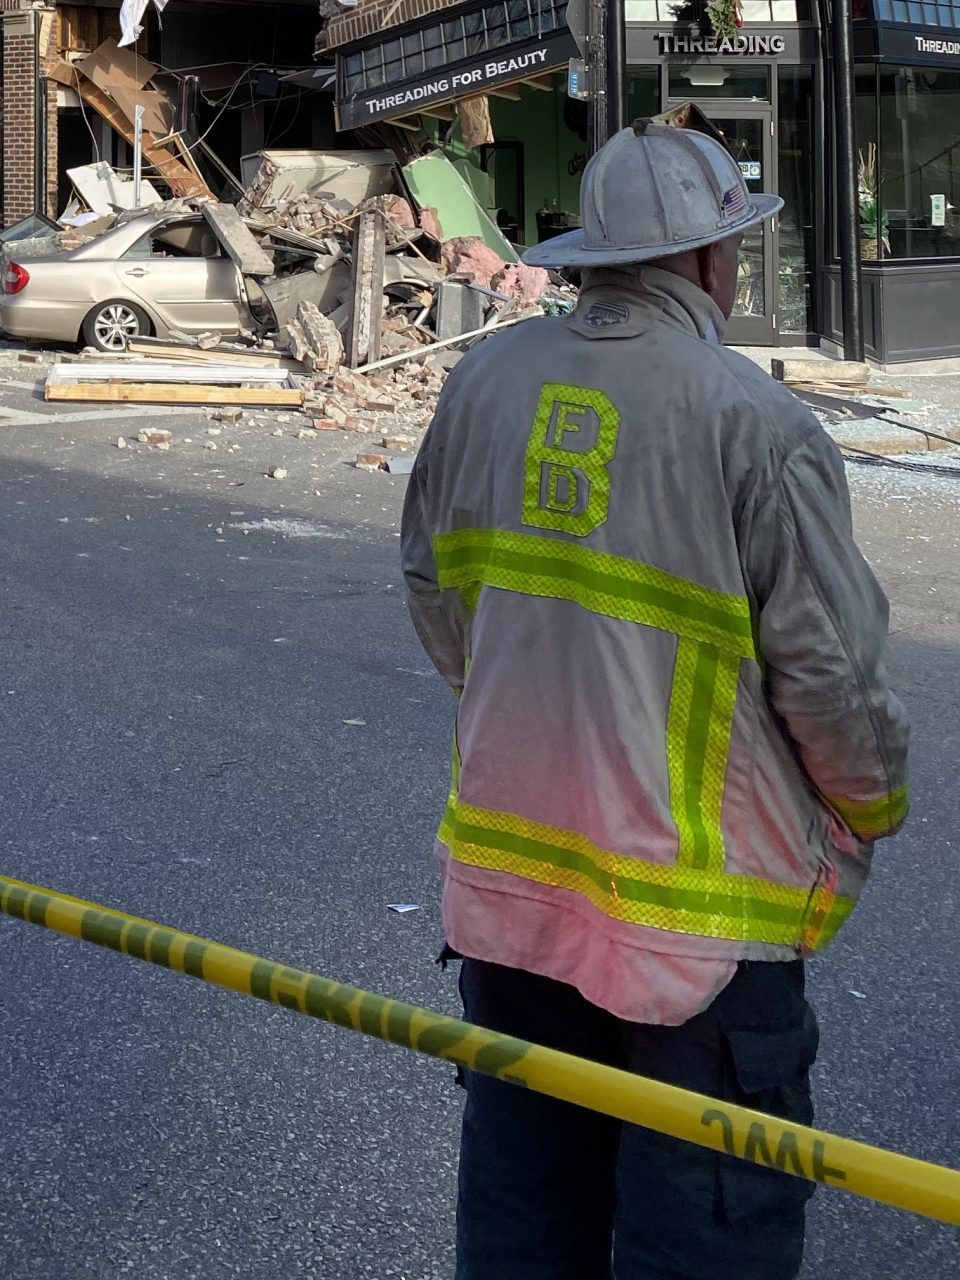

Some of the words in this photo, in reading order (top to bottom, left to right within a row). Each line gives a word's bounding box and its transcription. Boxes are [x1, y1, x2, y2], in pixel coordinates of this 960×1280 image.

[658, 32, 786, 53] THREADING
[366, 79, 449, 114] THREADING
[451, 69, 483, 88] FOR
[485, 48, 548, 78] BEAUTY
